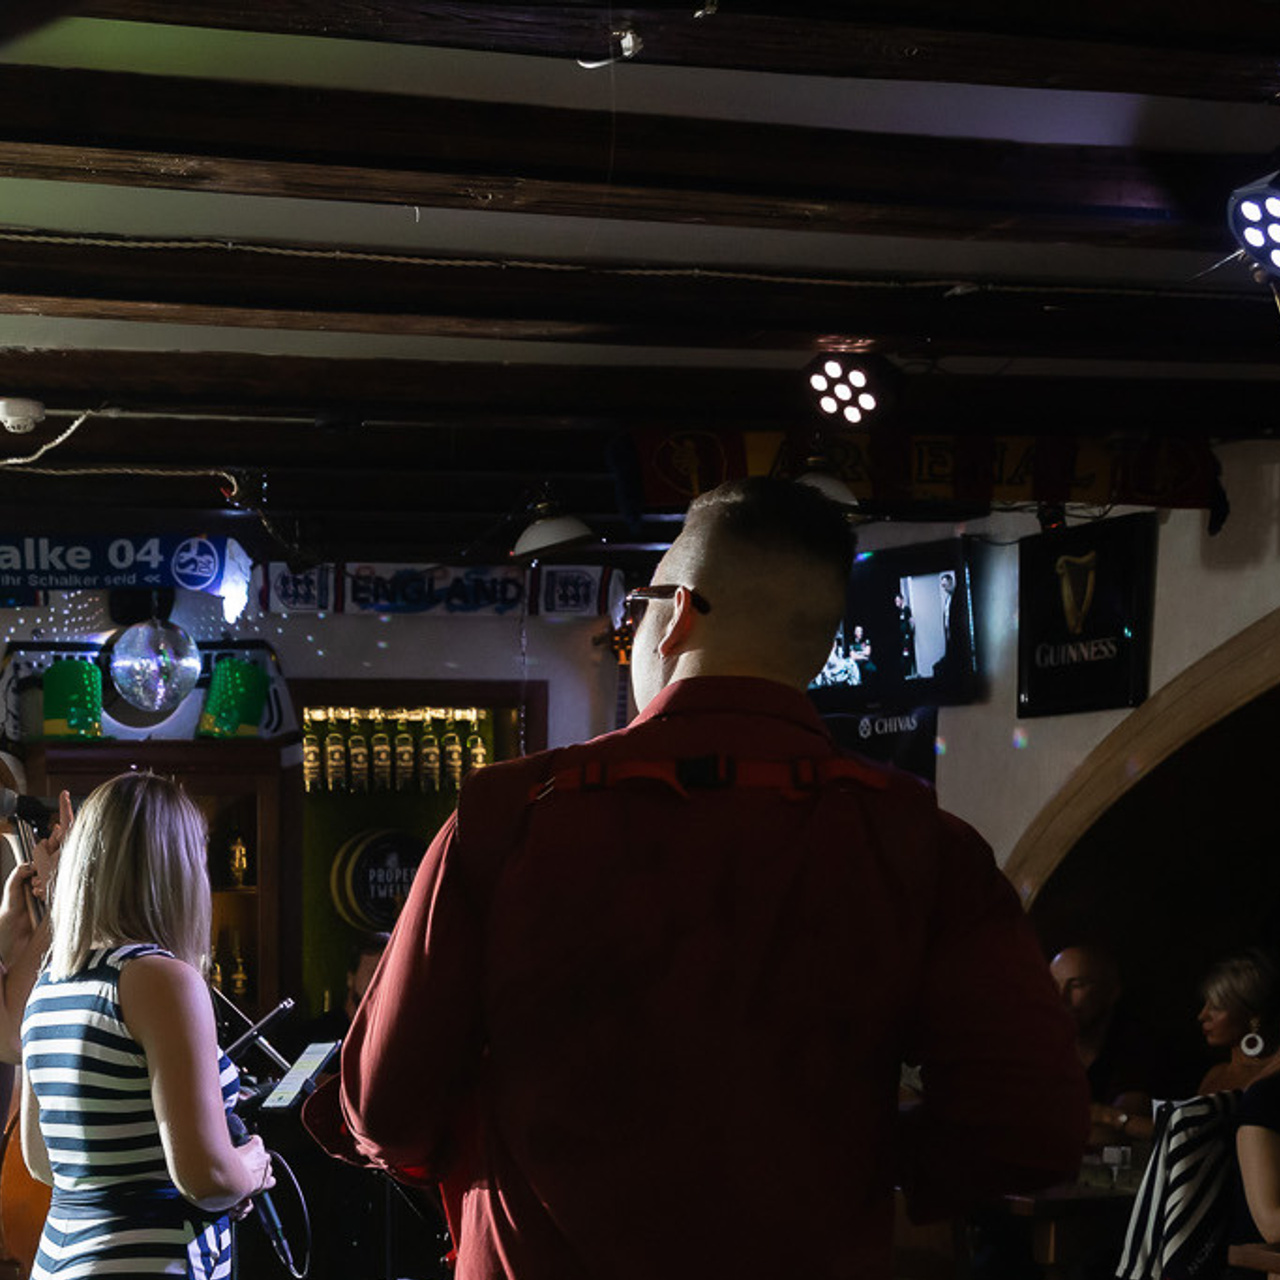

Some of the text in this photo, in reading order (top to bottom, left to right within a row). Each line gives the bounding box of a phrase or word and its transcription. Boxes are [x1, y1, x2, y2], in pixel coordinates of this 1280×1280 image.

[108, 538, 164, 570] 04
[27, 573, 100, 587] Schalker
[103, 573, 137, 586] seid
[1035, 636, 1118, 668] GUINNESS
[874, 714, 918, 735] CHIVAS
